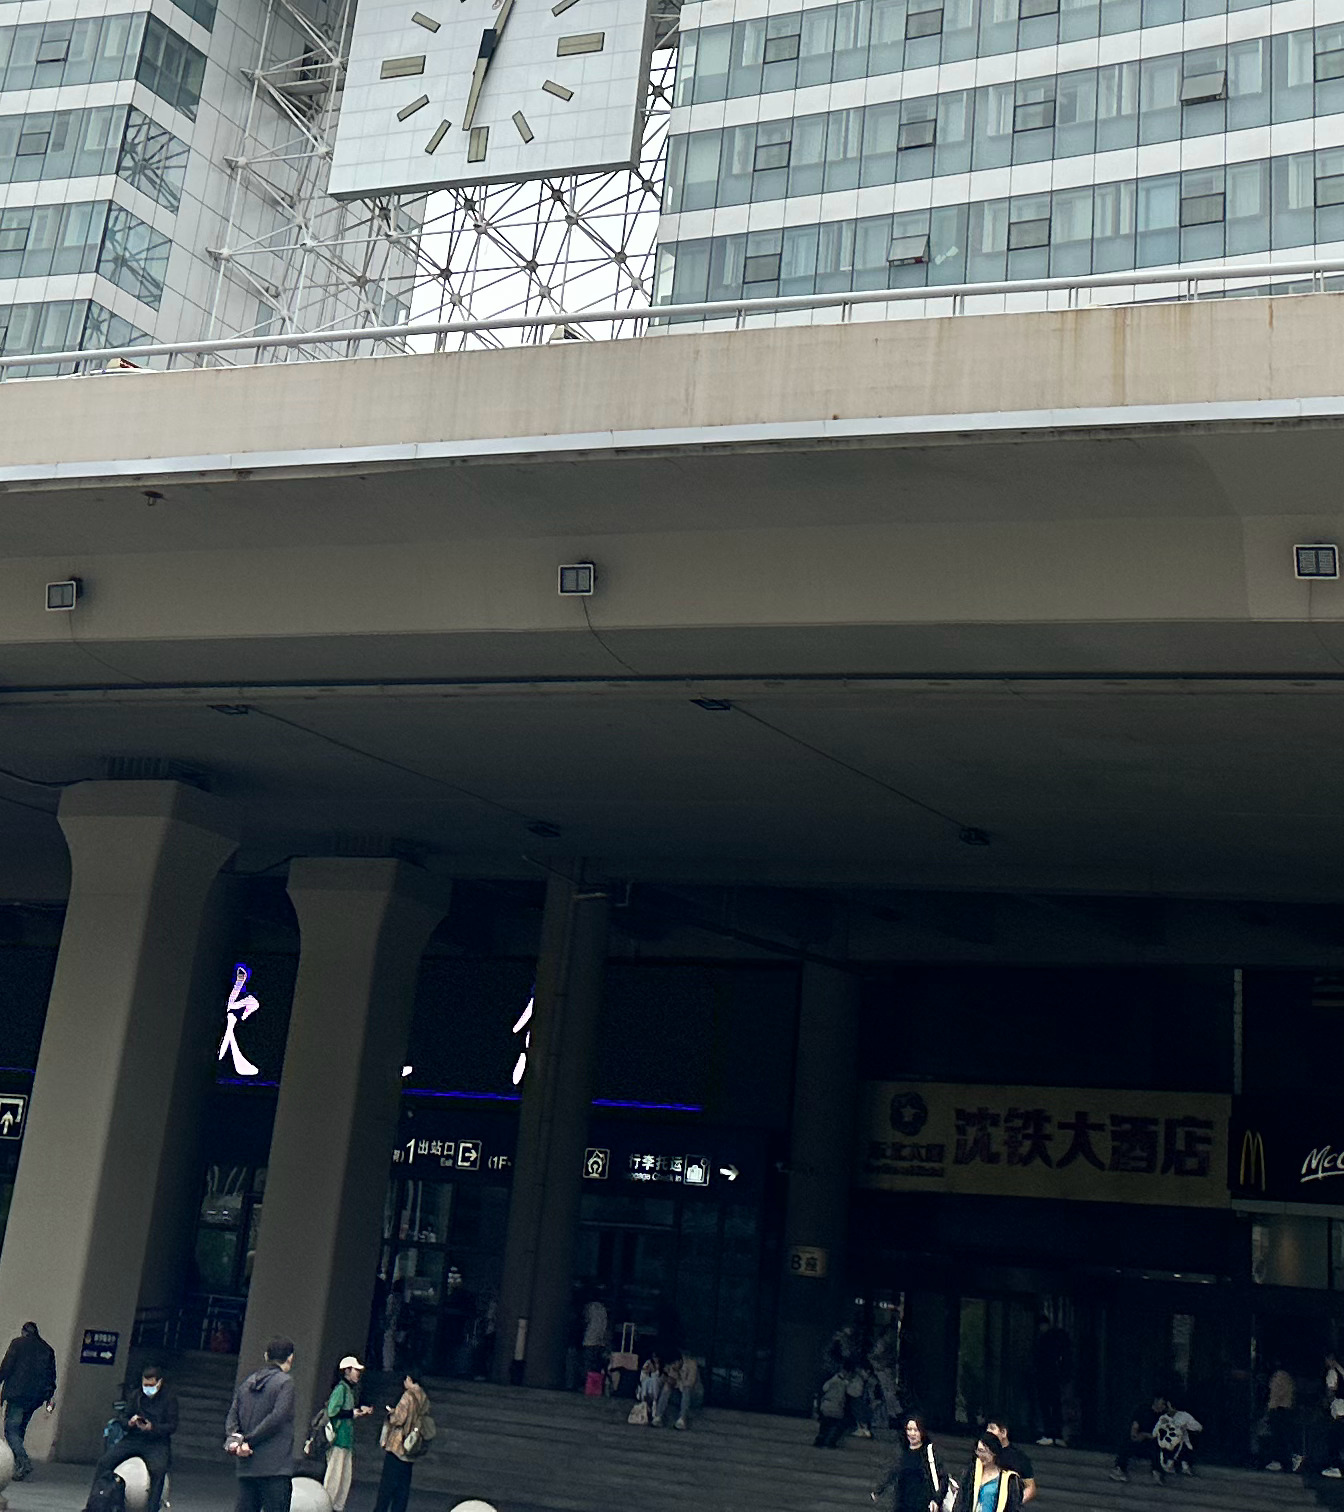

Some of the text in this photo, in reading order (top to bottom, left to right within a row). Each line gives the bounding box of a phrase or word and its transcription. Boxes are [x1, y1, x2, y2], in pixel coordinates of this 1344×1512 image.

[629, 1154, 683, 1172] 行李托运
[954, 1106, 1214, 1177] 沈铁大酒店
